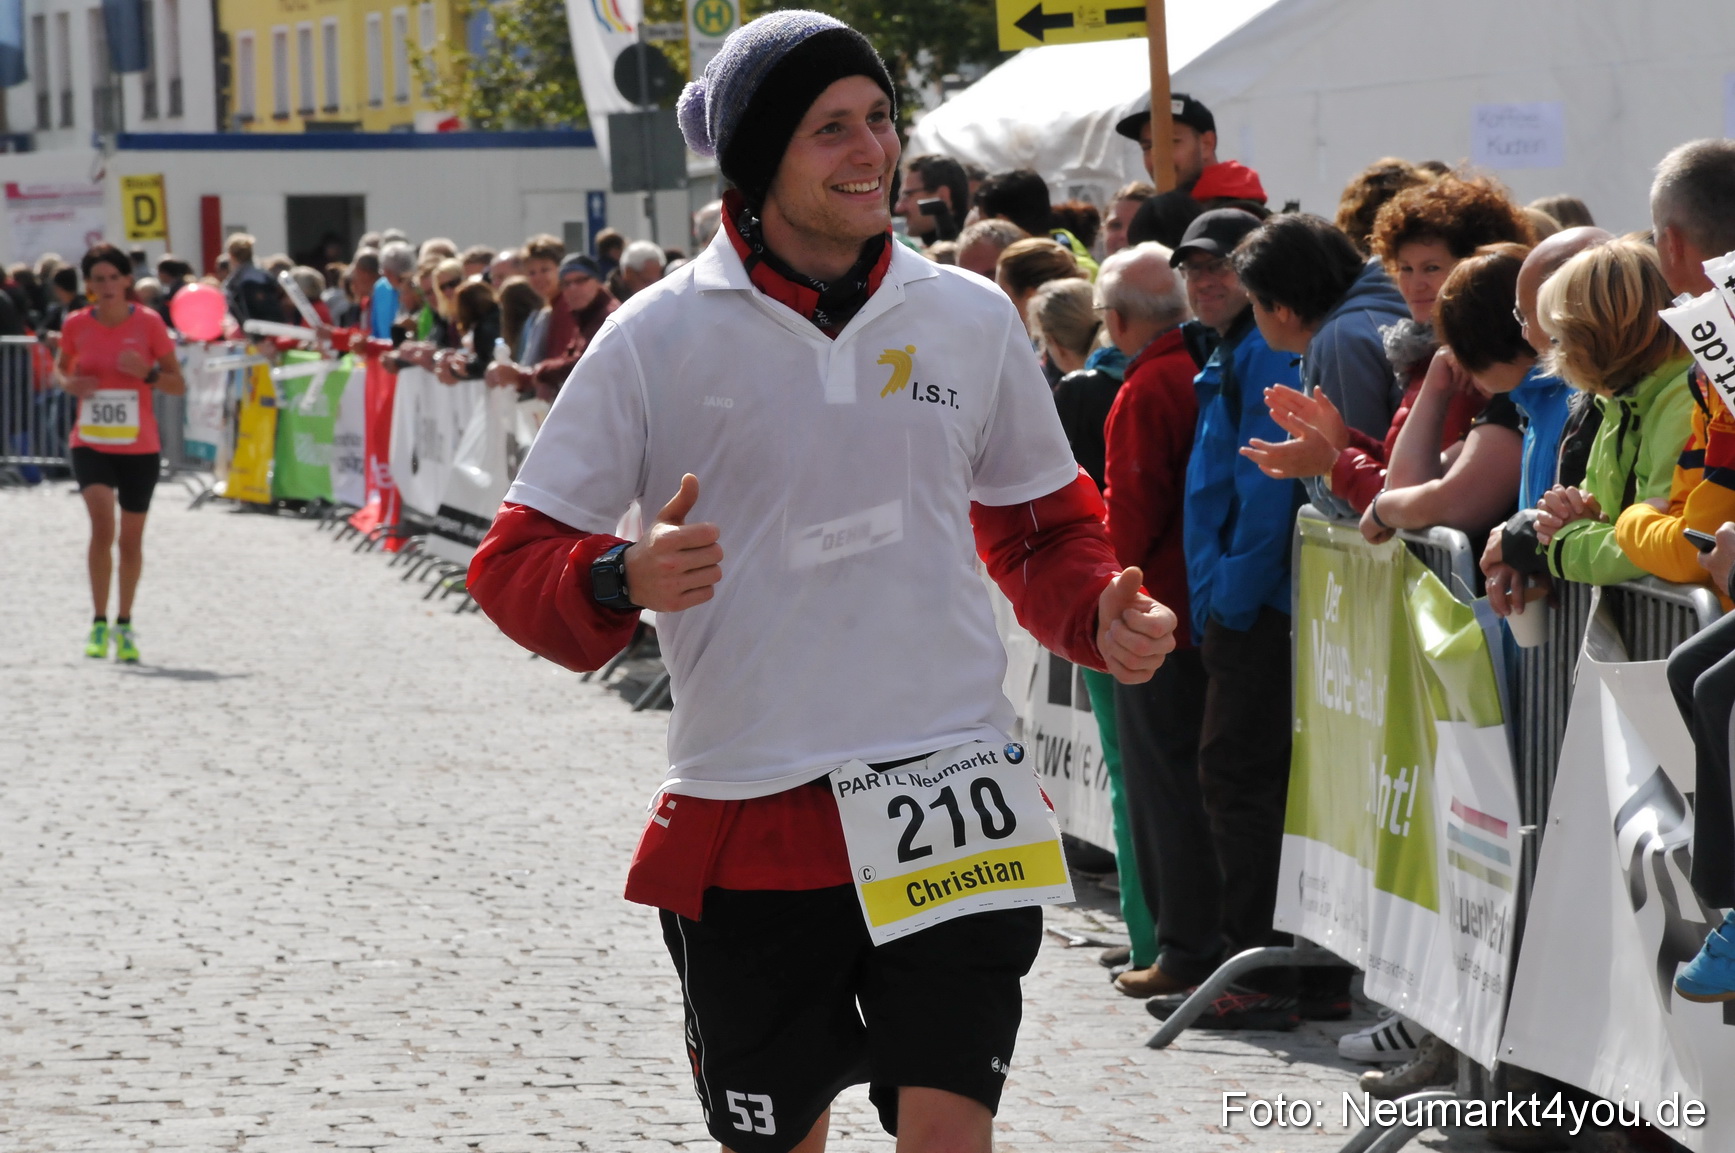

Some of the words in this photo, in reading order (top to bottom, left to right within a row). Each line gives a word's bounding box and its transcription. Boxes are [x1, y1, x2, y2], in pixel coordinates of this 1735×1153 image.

[133, 193, 157, 226] D
[91, 403, 127, 424] 506
[704, 395, 734, 409] JAKO
[912, 381, 960, 410] I.S.T.
[1325, 571, 1343, 623] Der
[837, 771, 907, 798] PARTL
[908, 750, 999, 788] Neumarkt
[887, 776, 1017, 864] 210
[906, 860, 1026, 907] Christian
[726, 1090, 776, 1136] 53
